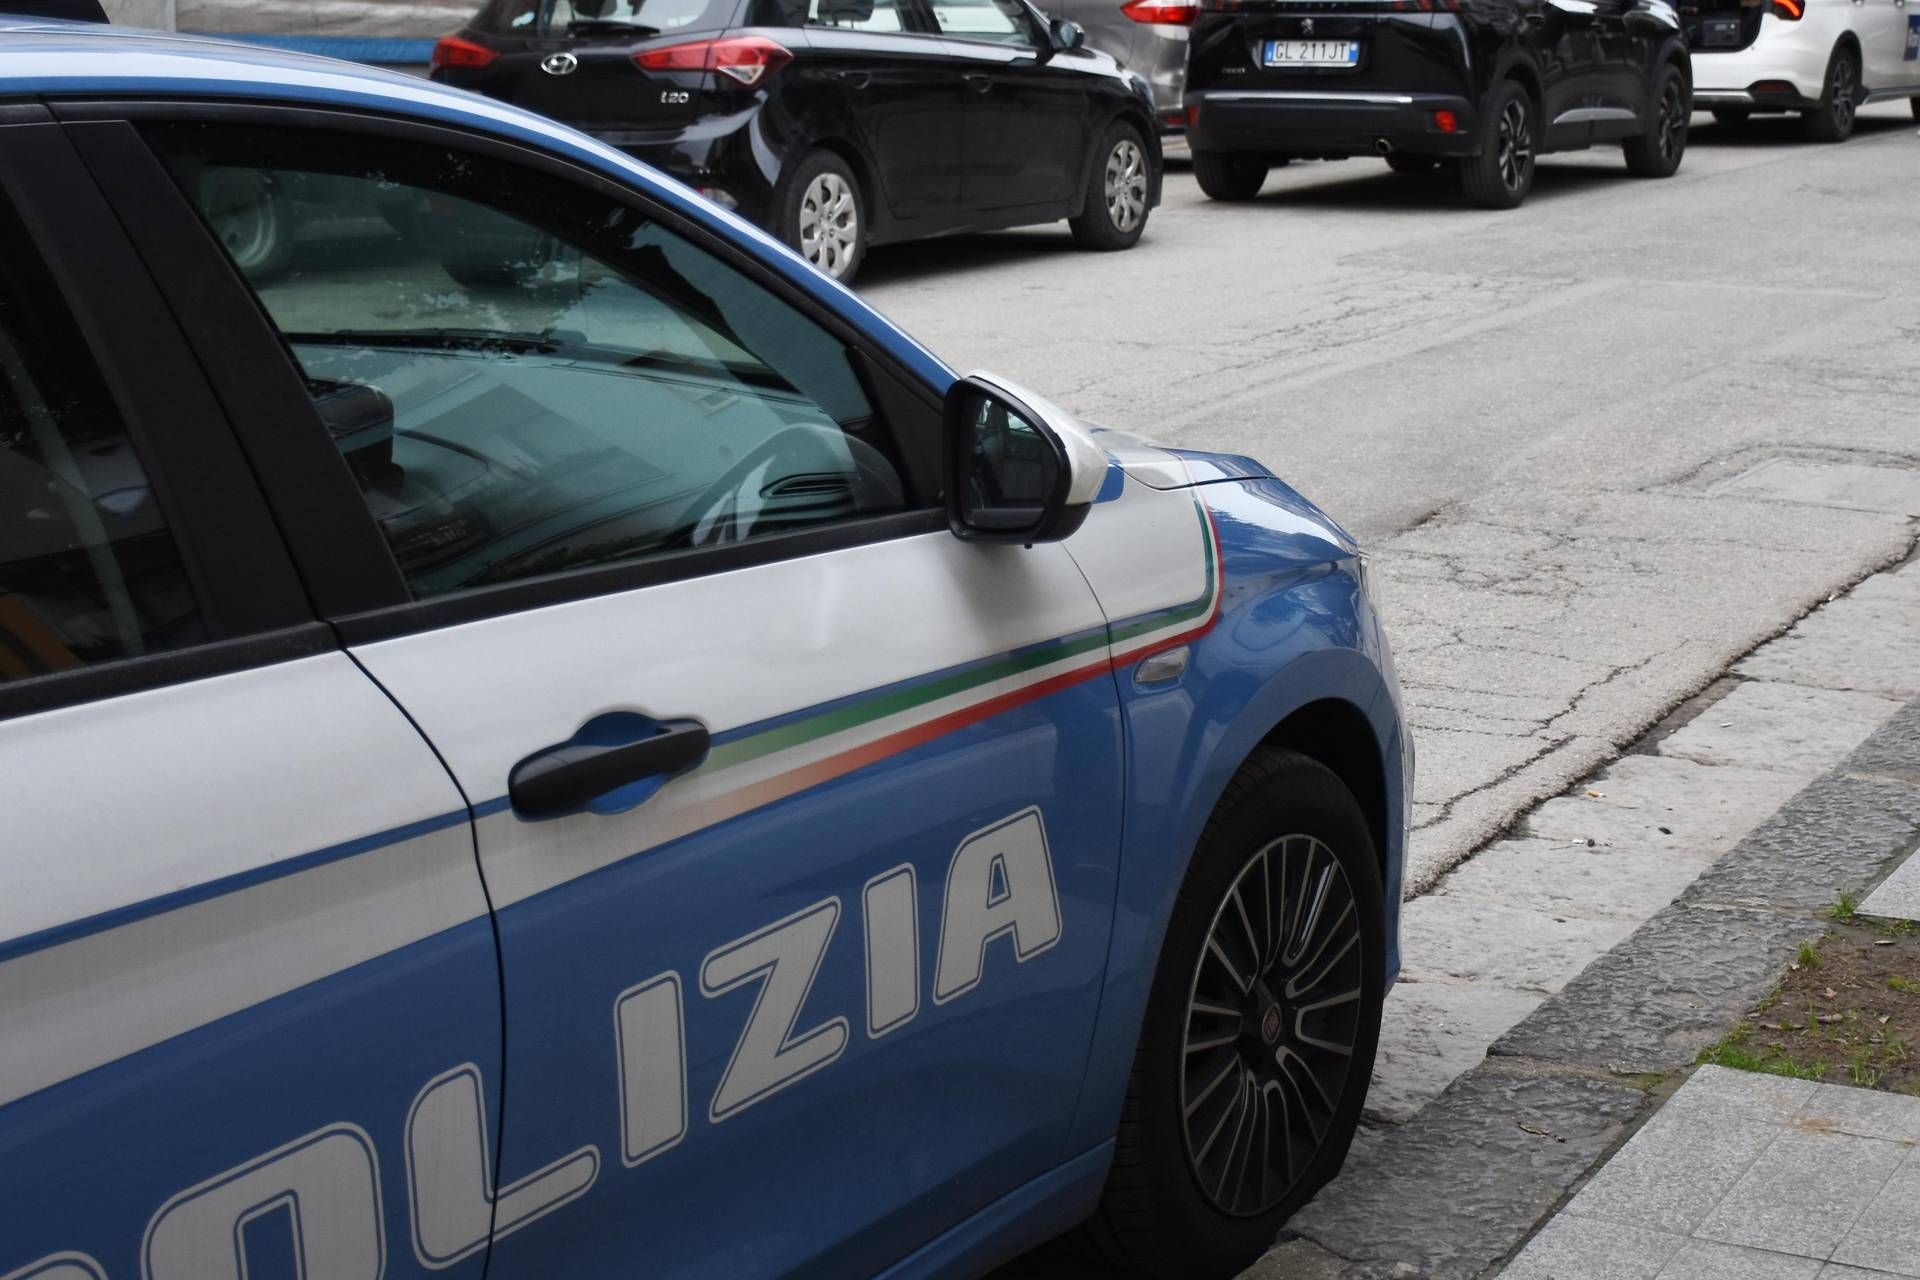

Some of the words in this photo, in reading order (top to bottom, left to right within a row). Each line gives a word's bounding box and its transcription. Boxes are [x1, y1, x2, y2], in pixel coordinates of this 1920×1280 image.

[1276, 42, 1292, 60] GL
[1300, 42, 1347, 60] 211JT
[0, 804, 1062, 1280] OLIZIA
